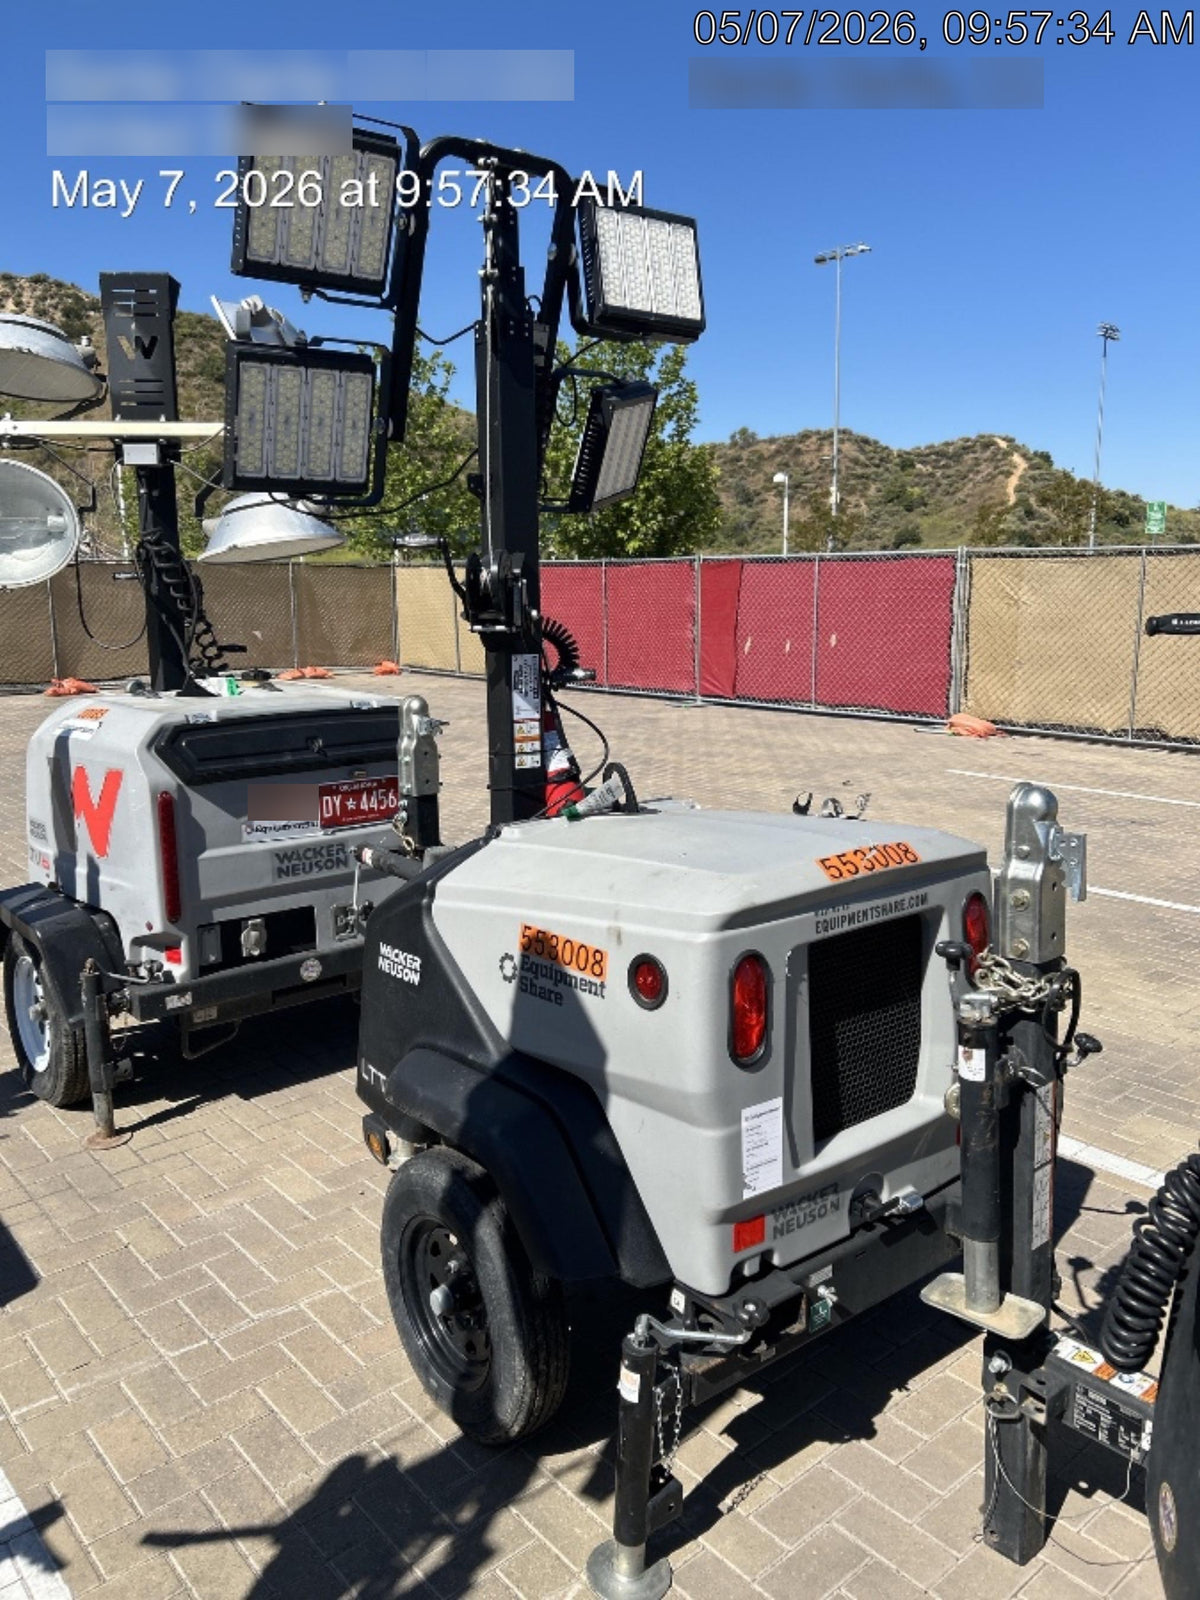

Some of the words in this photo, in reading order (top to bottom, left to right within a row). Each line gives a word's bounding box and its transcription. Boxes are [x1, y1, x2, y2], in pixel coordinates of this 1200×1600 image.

[322, 794, 342, 818] DY
[360, 788, 397, 811] 4456
[274, 843, 347, 865] WACKER
[276, 856, 349, 879] NEUSON
[818, 842, 919, 879] 553008
[815, 892, 929, 935] EQUIPMENTSHARE.COM
[379, 942, 422, 969] WACKER
[521, 925, 604, 977] 553008
[378, 955, 421, 986] NEUSON
[520, 953, 607, 1000] Equipment
[519, 978, 564, 1007] Share
[771, 1182, 839, 1223] WACKER
[773, 1197, 841, 1240] NEUSON
